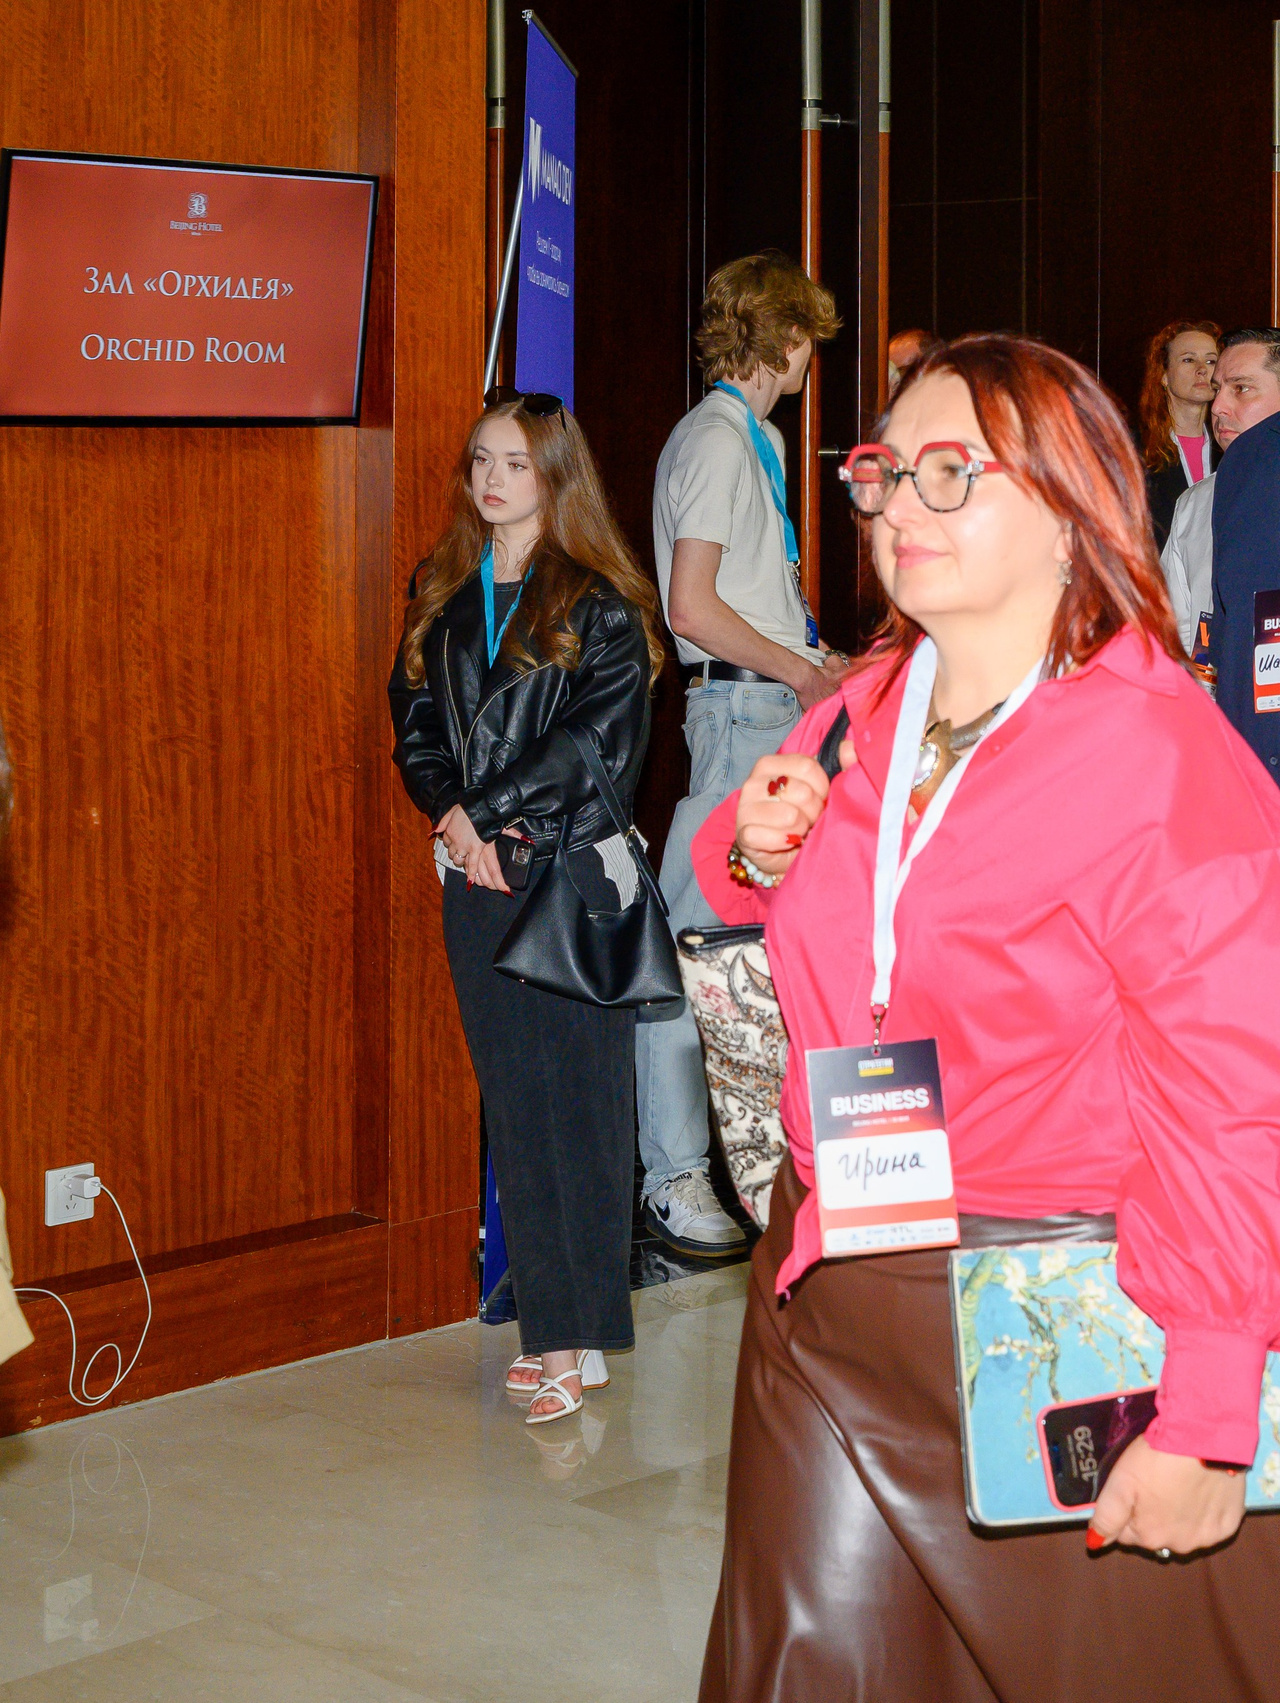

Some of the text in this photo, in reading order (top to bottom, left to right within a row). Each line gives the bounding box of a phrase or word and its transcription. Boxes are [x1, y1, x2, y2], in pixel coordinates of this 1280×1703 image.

[80, 333, 286, 364] ORCHID ROOM
[830, 1088, 930, 1117] BUSINESS
[838, 1147, 926, 1191] Ирина
